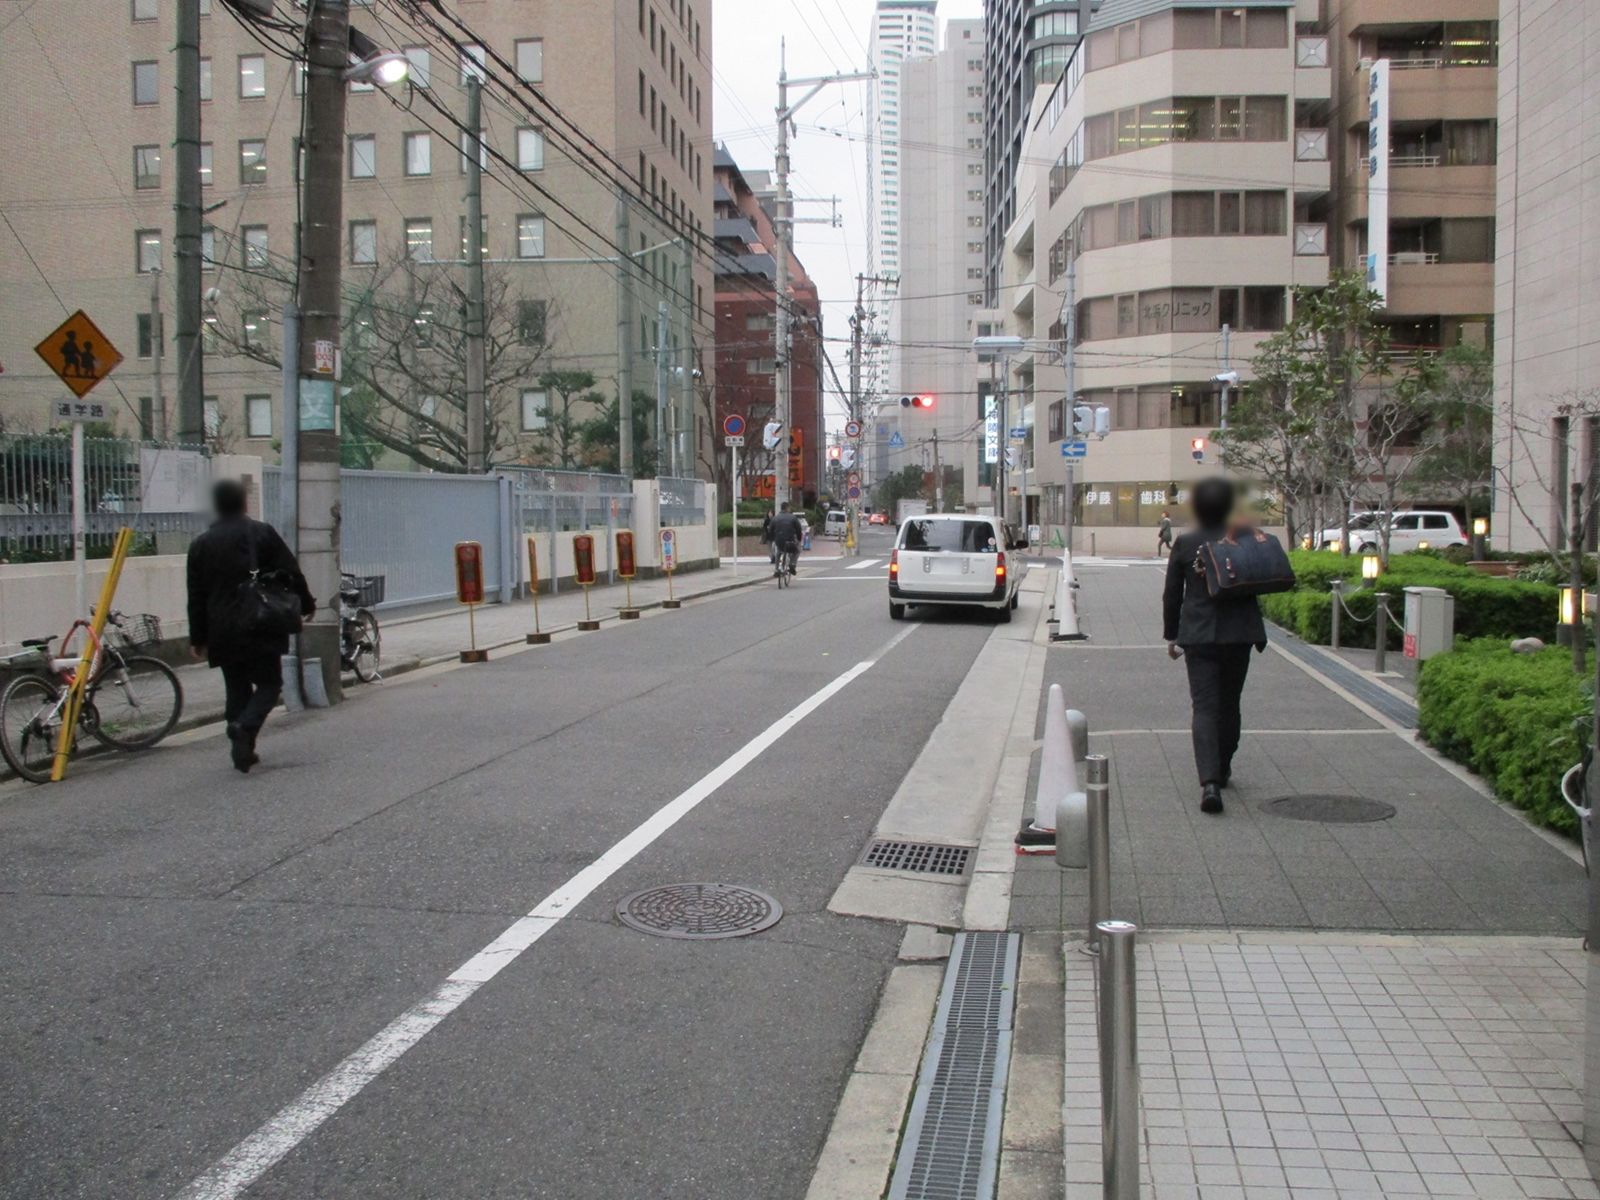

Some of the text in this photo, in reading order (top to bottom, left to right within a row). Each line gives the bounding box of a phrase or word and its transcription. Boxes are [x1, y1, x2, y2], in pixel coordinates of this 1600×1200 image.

[58, 403, 103, 417] 通学路
[1140, 490, 1165, 504] 歯科
